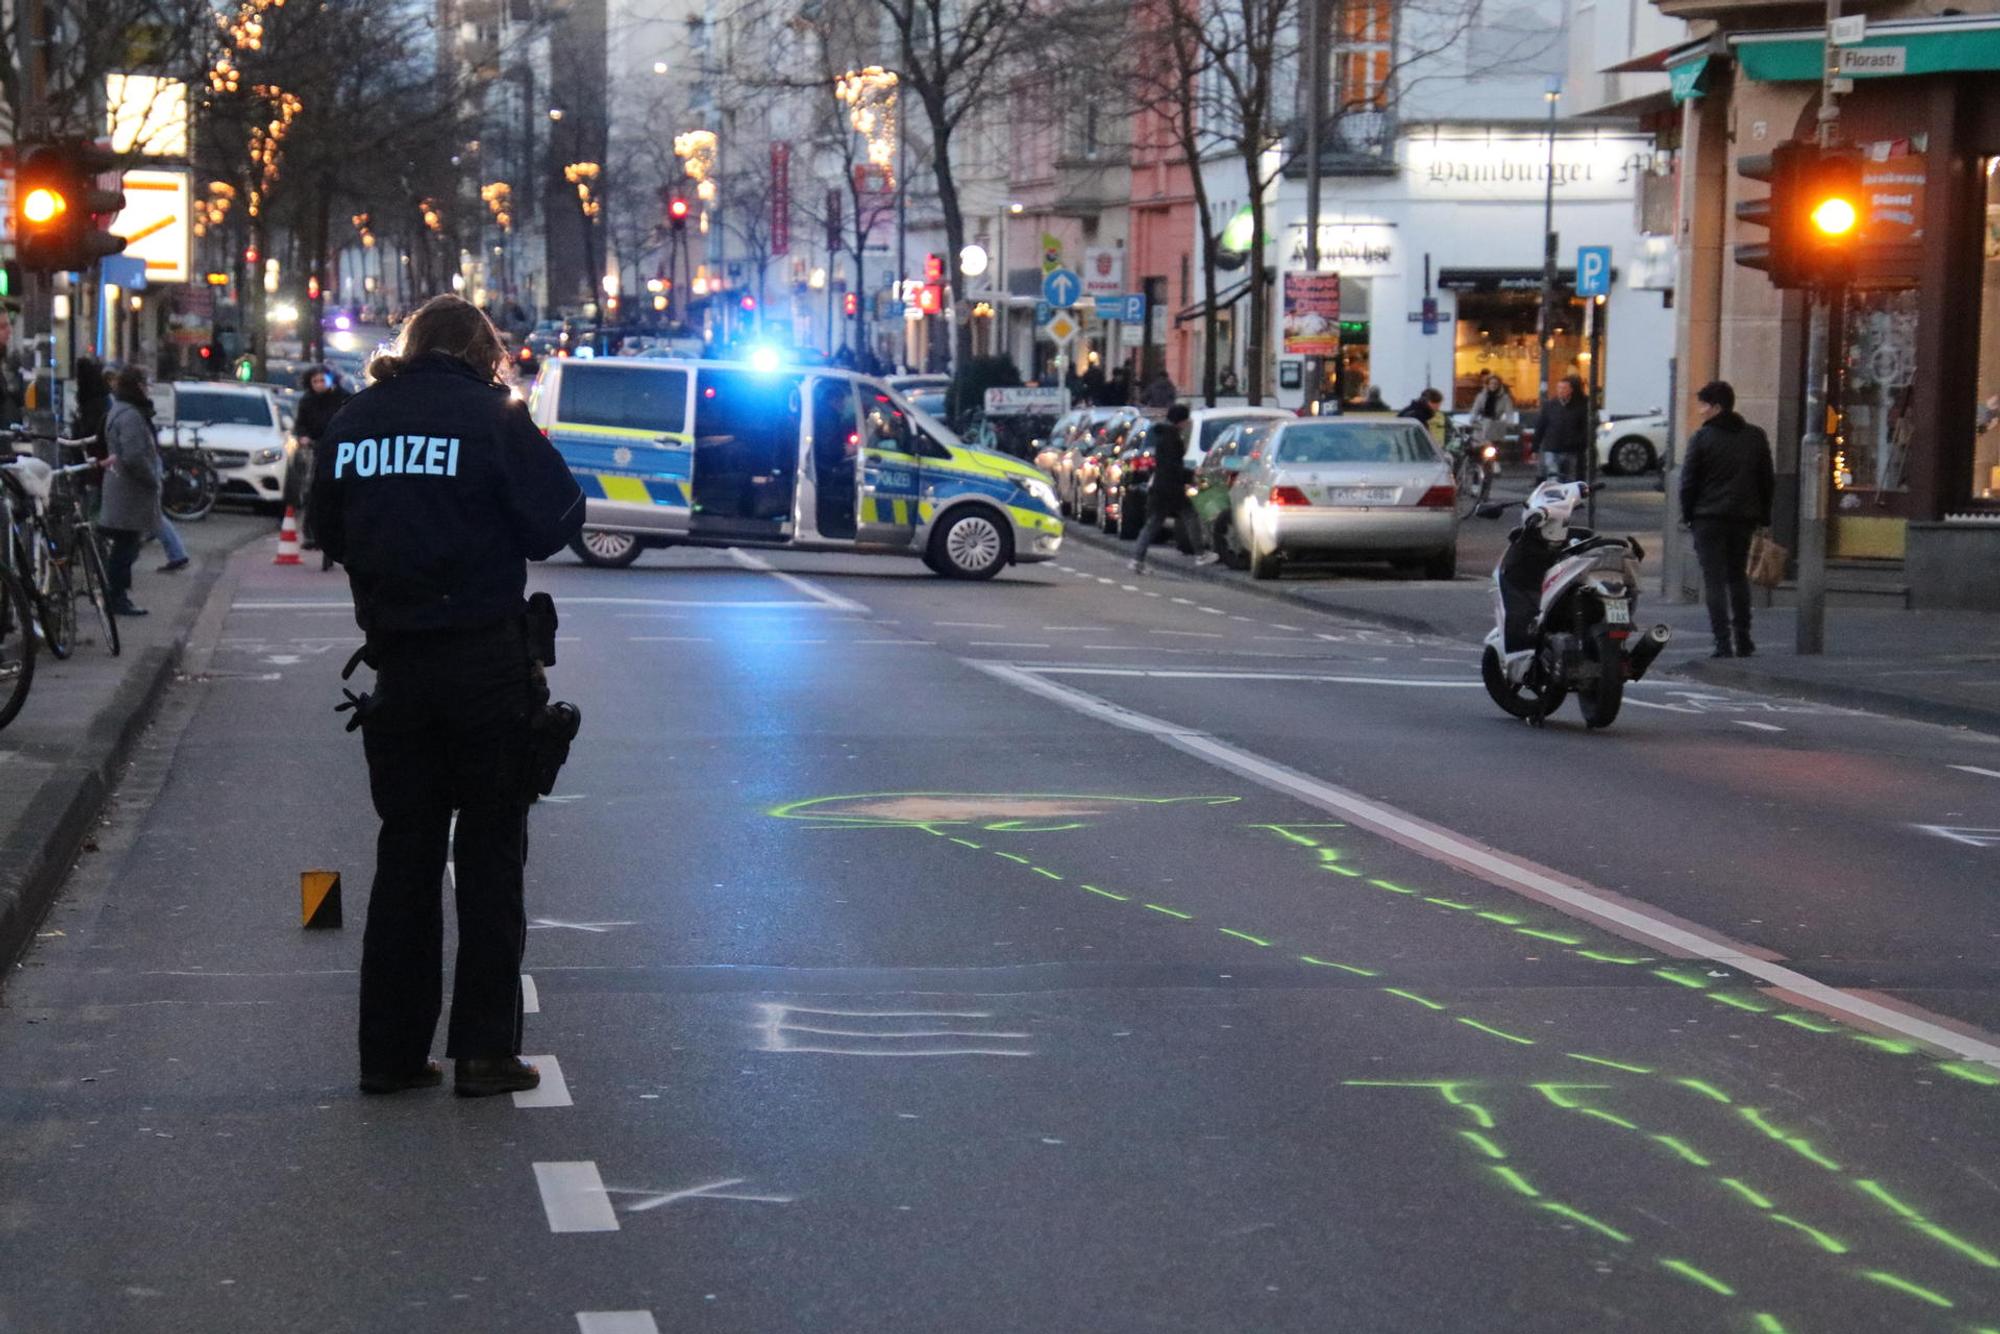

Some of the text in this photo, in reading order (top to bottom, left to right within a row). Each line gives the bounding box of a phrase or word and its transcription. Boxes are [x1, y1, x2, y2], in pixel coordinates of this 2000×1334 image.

[1584, 253, 1602, 290] P
[335, 435, 460, 479] POLIZEI
[876, 470, 911, 487] POLIZEI
